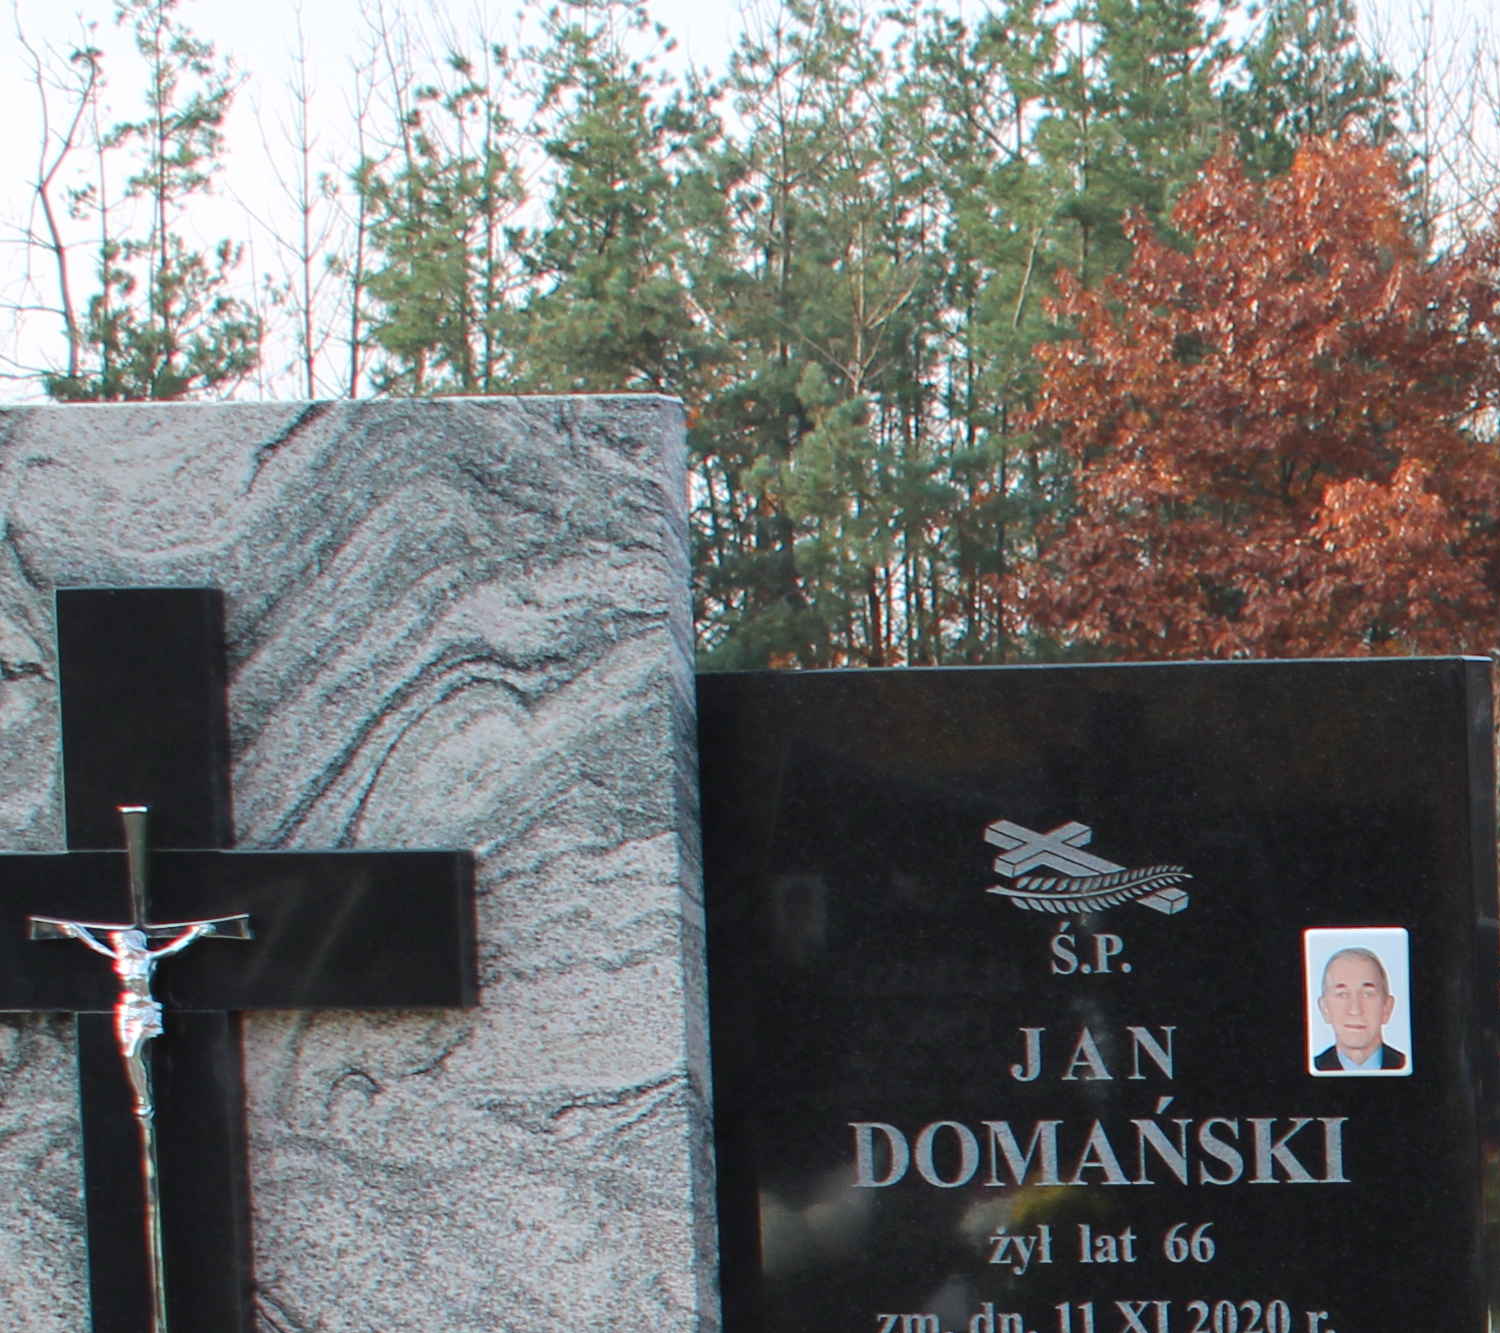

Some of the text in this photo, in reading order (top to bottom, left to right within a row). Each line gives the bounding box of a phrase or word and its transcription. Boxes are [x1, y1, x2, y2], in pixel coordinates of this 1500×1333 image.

[1050, 920, 1132, 976] Ś.P.
[1010, 1025, 1177, 1083] JAN
[847, 1096, 1351, 1189] DOMAŃSKI
[988, 1223, 1216, 1276] żył lat 66
